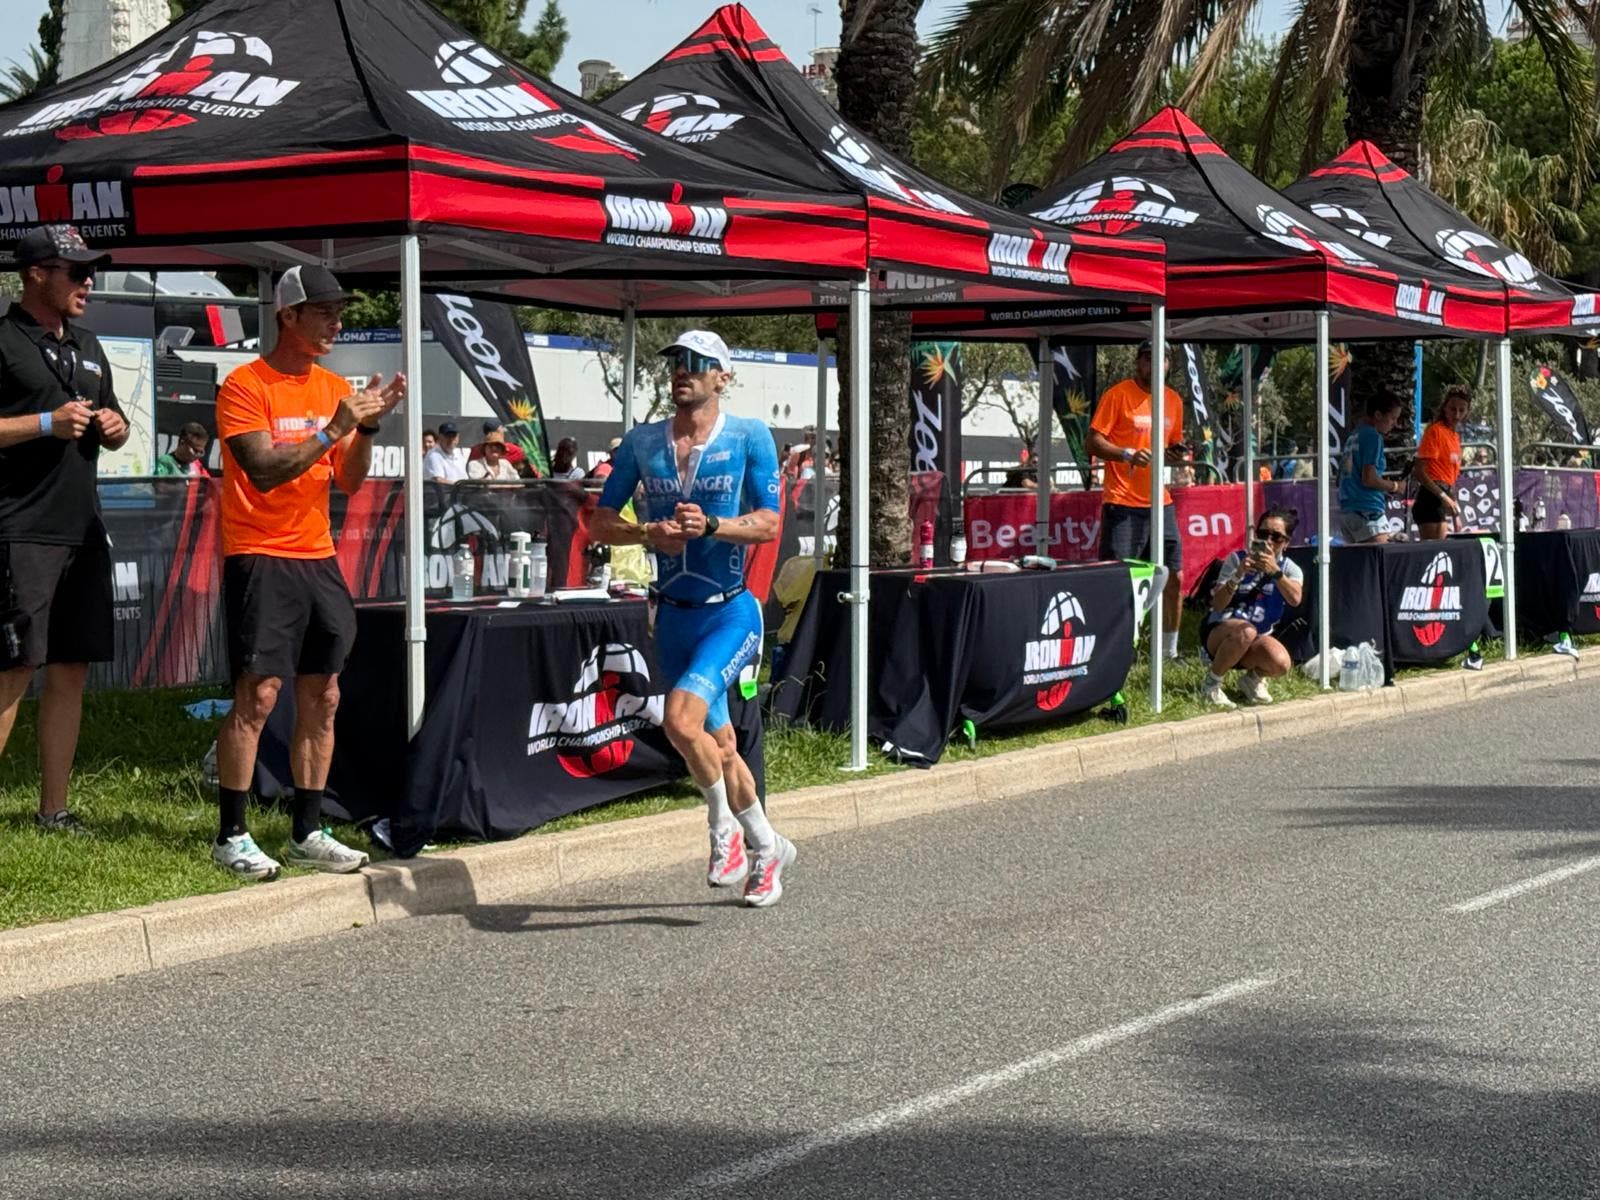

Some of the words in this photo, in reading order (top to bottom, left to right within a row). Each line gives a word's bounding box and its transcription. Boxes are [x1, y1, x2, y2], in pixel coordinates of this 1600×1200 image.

[188, 100, 265, 119] EVENTS
[453, 119, 508, 131] WORLD
[507, 113, 582, 131] CHAMPIO
[605, 188, 727, 239] IRONMAN
[1137, 214, 1187, 228] EVENTS
[81, 224, 127, 237] EVENTS
[606, 232, 636, 247] WORLD
[635, 235, 693, 252] CHAMPIONSHIP
[692, 241, 722, 256] EVENTS
[988, 229, 1071, 272] IRONMAN
[990, 312, 1021, 321] WORLD
[1022, 308, 1087, 320] CHAMPIONSHIP
[1087, 306, 1121, 316] EVENTS
[1188, 512, 1233, 536] an
[1487, 543, 1503, 587] 2
[1024, 634, 1096, 672] IRONMAN
[528, 685, 665, 738] IRONMAN
[527, 737, 556, 757] WORLD
[557, 724, 621, 747] CHAMPIONSHIP
